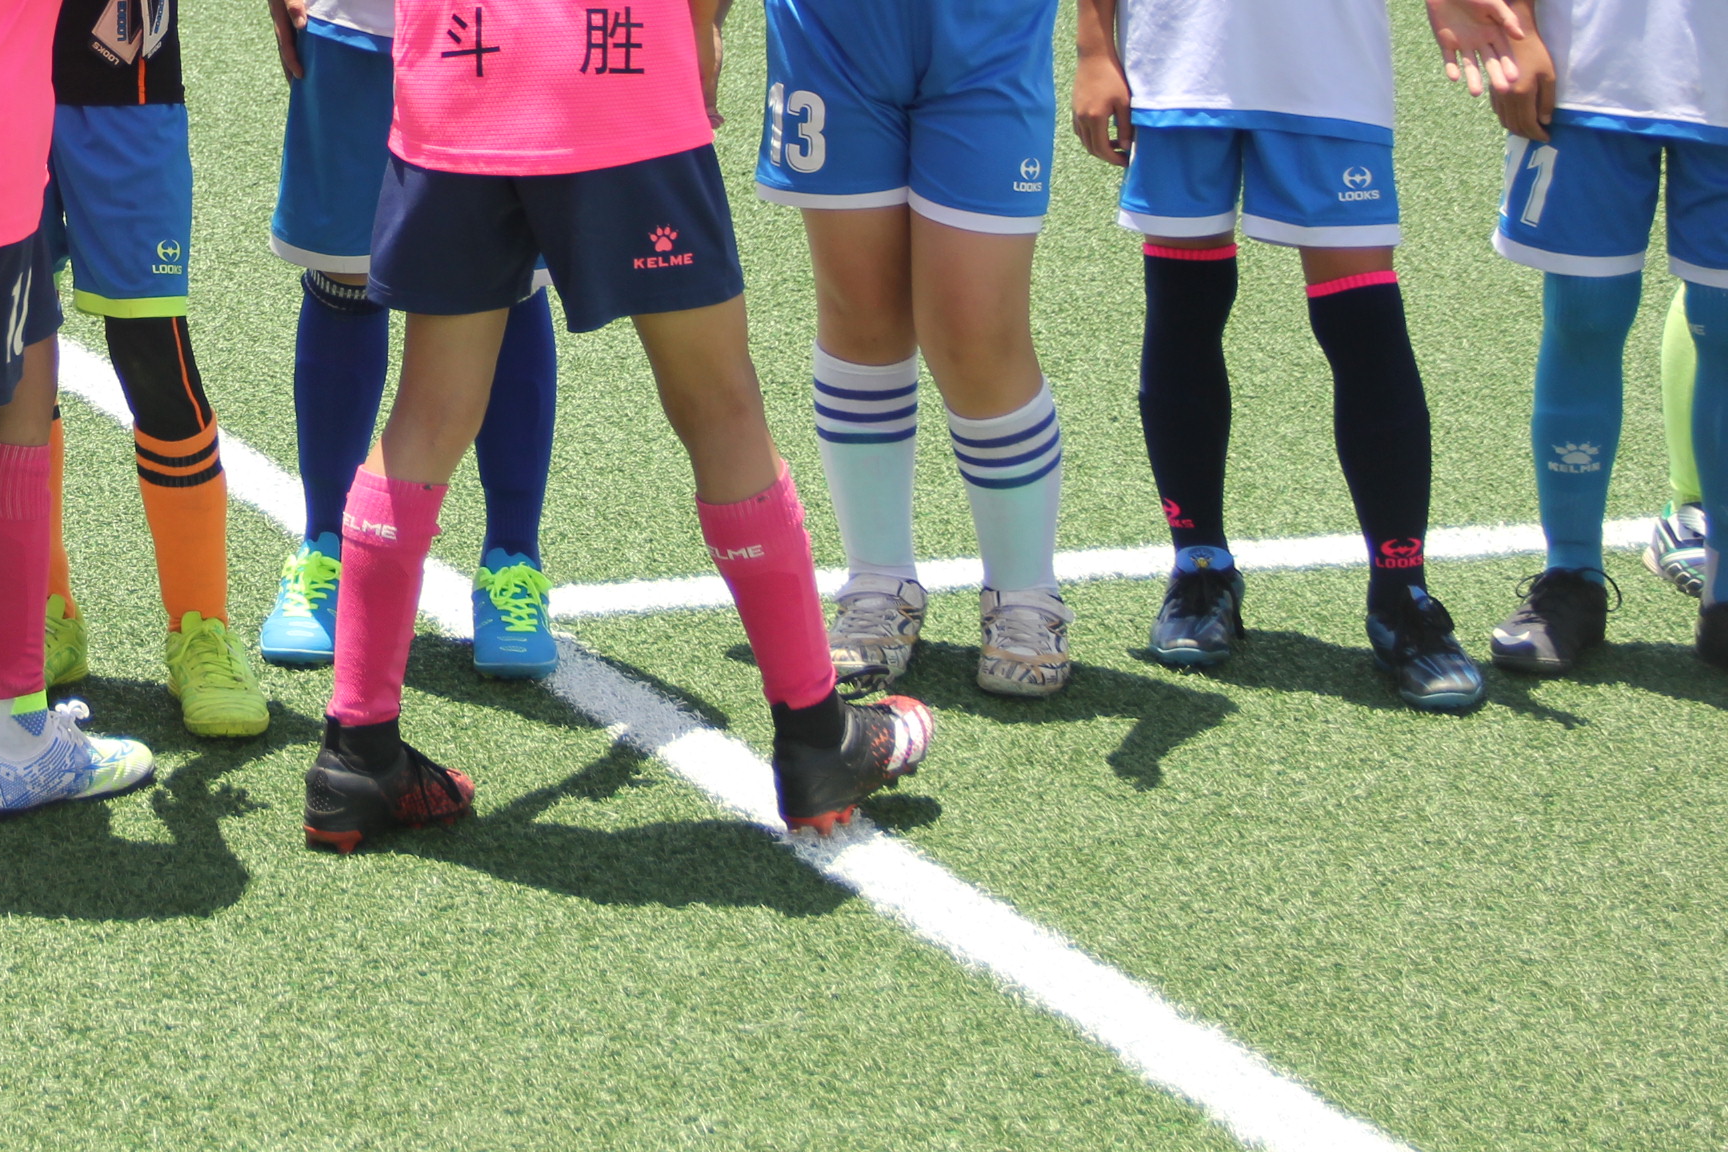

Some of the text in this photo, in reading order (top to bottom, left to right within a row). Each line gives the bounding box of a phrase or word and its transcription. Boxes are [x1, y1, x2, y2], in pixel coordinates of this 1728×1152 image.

[768, 82, 827, 174] 13
[1013, 181, 1043, 193] LOOKS
[1338, 189, 1380, 202] LOOKS
[633, 253, 694, 270] KELME
[152, 264, 183, 275] LOOKS
[343, 511, 398, 540] ELME
